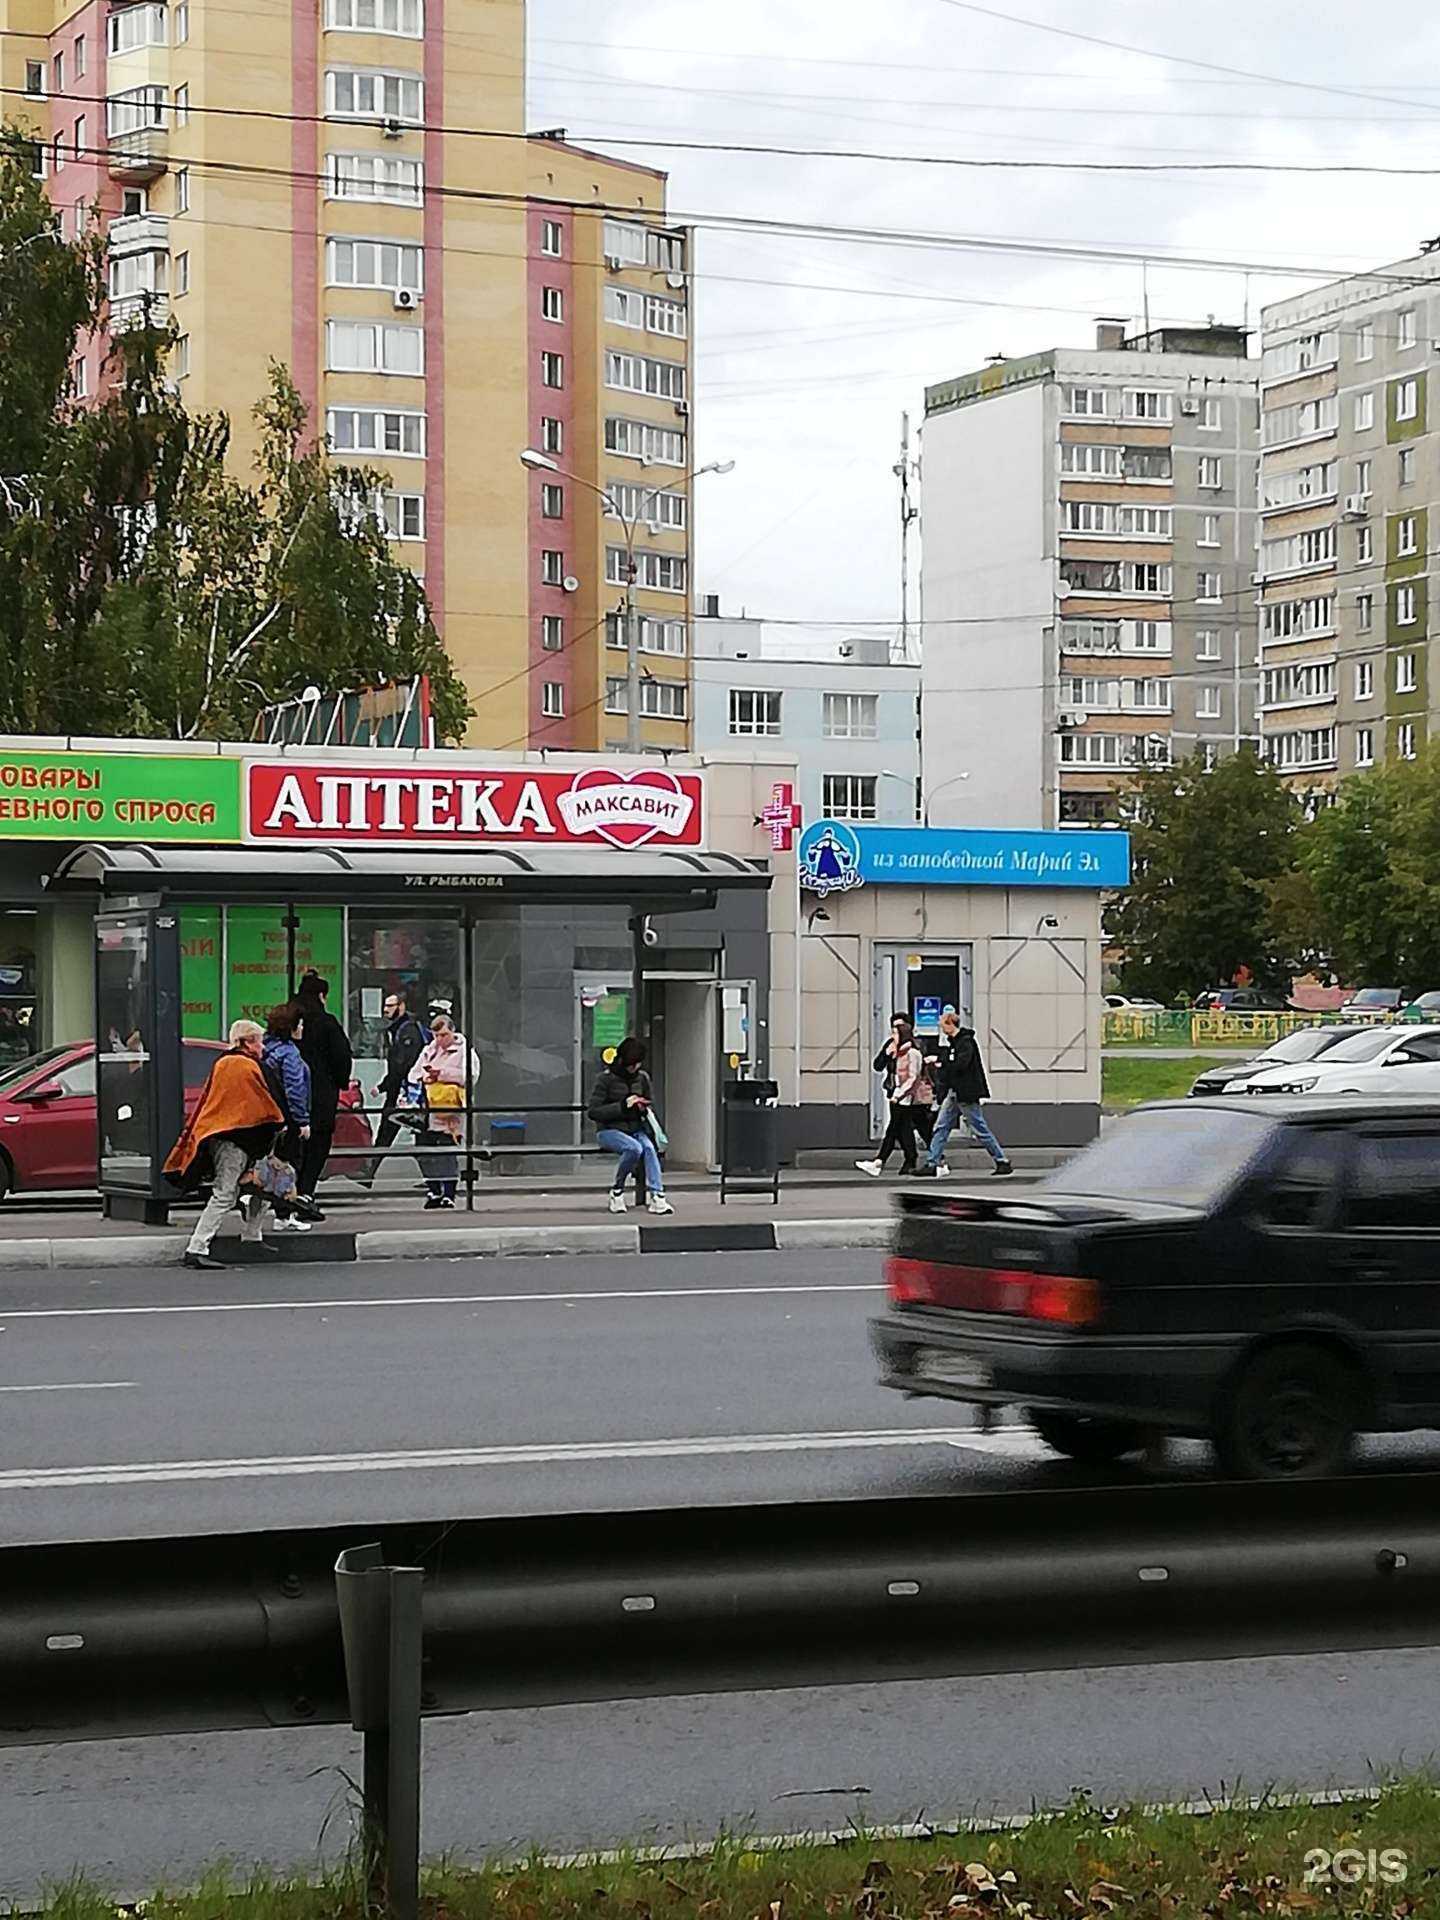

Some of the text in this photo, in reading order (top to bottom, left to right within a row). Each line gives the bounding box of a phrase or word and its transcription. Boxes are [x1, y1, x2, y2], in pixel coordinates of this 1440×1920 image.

[114, 800, 216, 824] СПРОСА
[263, 774, 556, 834] АПТЕКА
[576, 796, 679, 819] МАКСАВИТ
[872, 853, 894, 868] из
[898, 850, 1004, 869] заповедной
[1010, 850, 1072, 876] Марий
[428, 875, 504, 887] РЫБАКОВА
